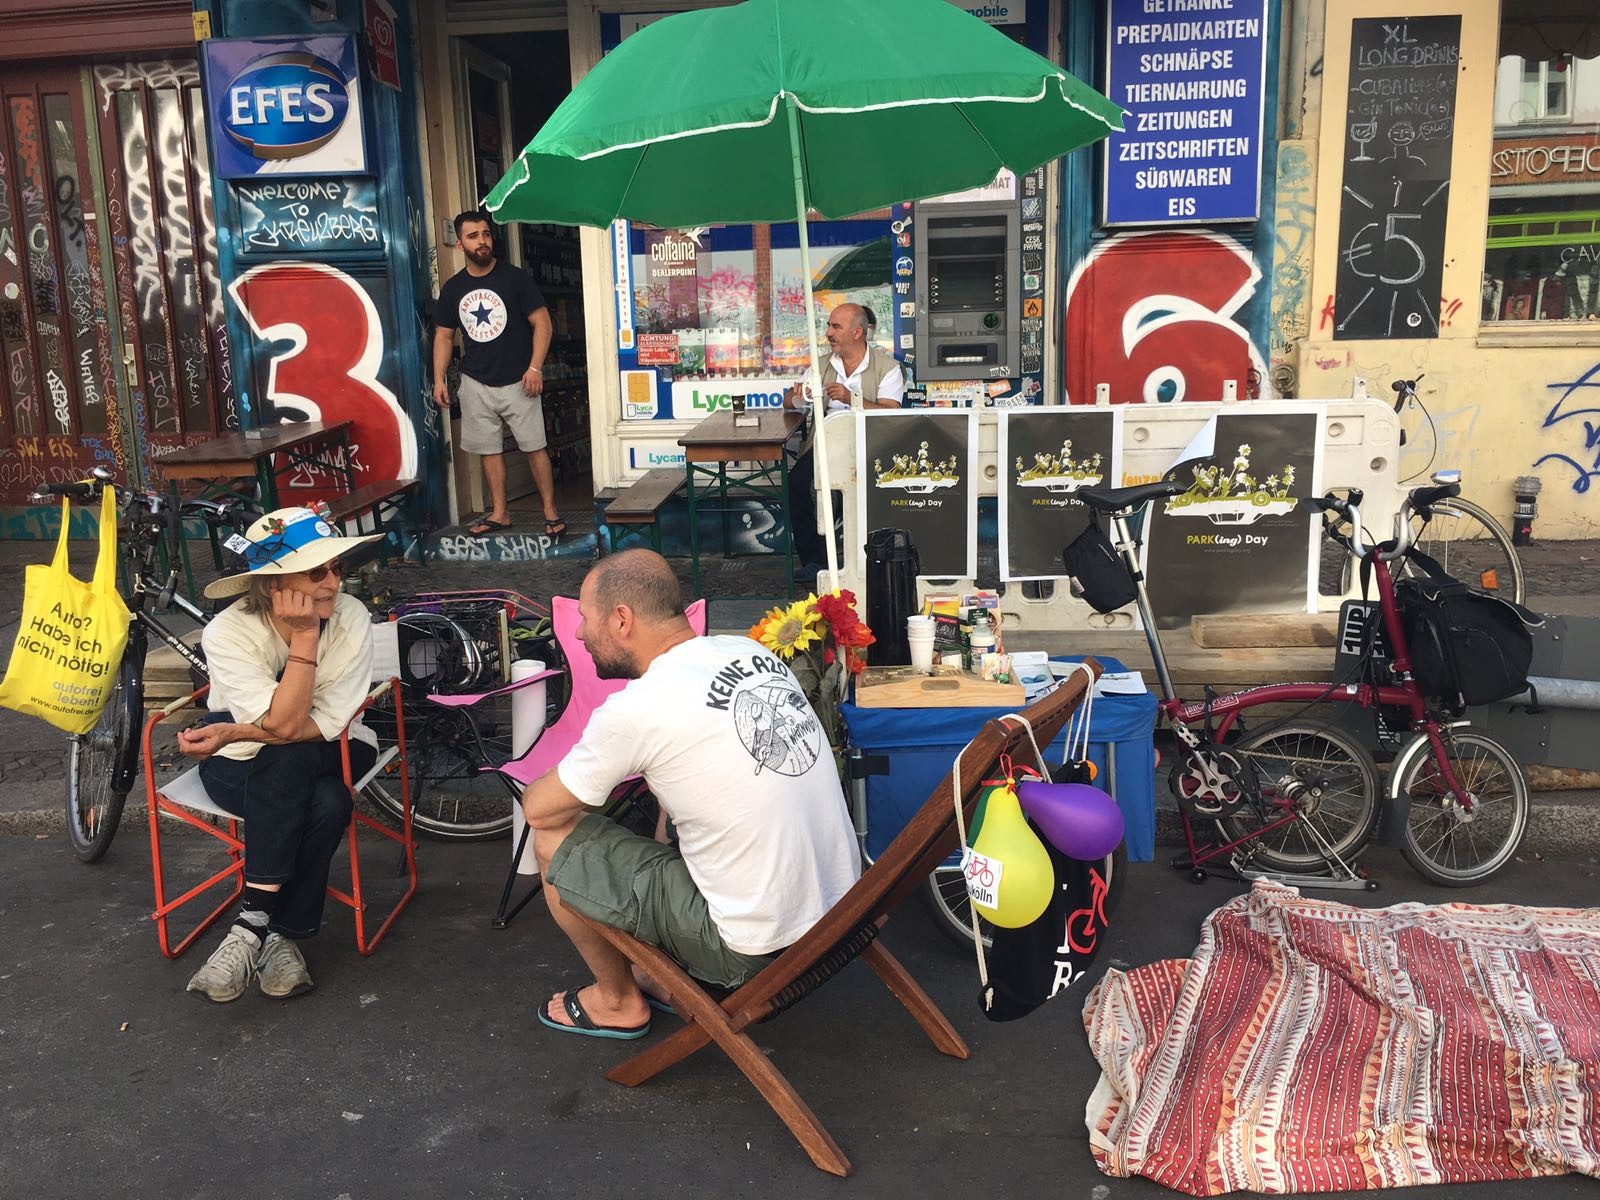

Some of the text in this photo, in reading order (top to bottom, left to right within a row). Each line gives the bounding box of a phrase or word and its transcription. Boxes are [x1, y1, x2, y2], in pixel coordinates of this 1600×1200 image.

[1117, 19, 1259, 44] PREPAIDKARTEN
[1382, 24, 1418, 44] XL
[1140, 48, 1233, 72] SCHNÄPSE
[1359, 46, 1408, 66] LONG
[1126, 79, 1246, 103] TIERNAHRUNG
[230, 82, 336, 125] EFES
[1137, 109, 1232, 132] ZEITUNGEN
[1120, 137, 1249, 161] ZEITSCHRIFTEN
[280, 202, 310, 219] TO
[1168, 197, 1196, 216] EIS
[652, 268, 696, 277] DEALERPOINT
[226, 261, 418, 480] 3
[928, 499, 942, 508] Day
[1186, 534, 1268, 547] PARK(ing) Day
[30, 616, 102, 654] Habe ich
[18, 635, 110, 677] nicht nötig!
[189, 654, 206, 671] AUTO
[52, 680, 103, 696] autofrei
[706, 655, 788, 711] KEINE A20
[30, 696, 94, 716] www.autofrei.de
[57, 694, 100, 707] leben!
